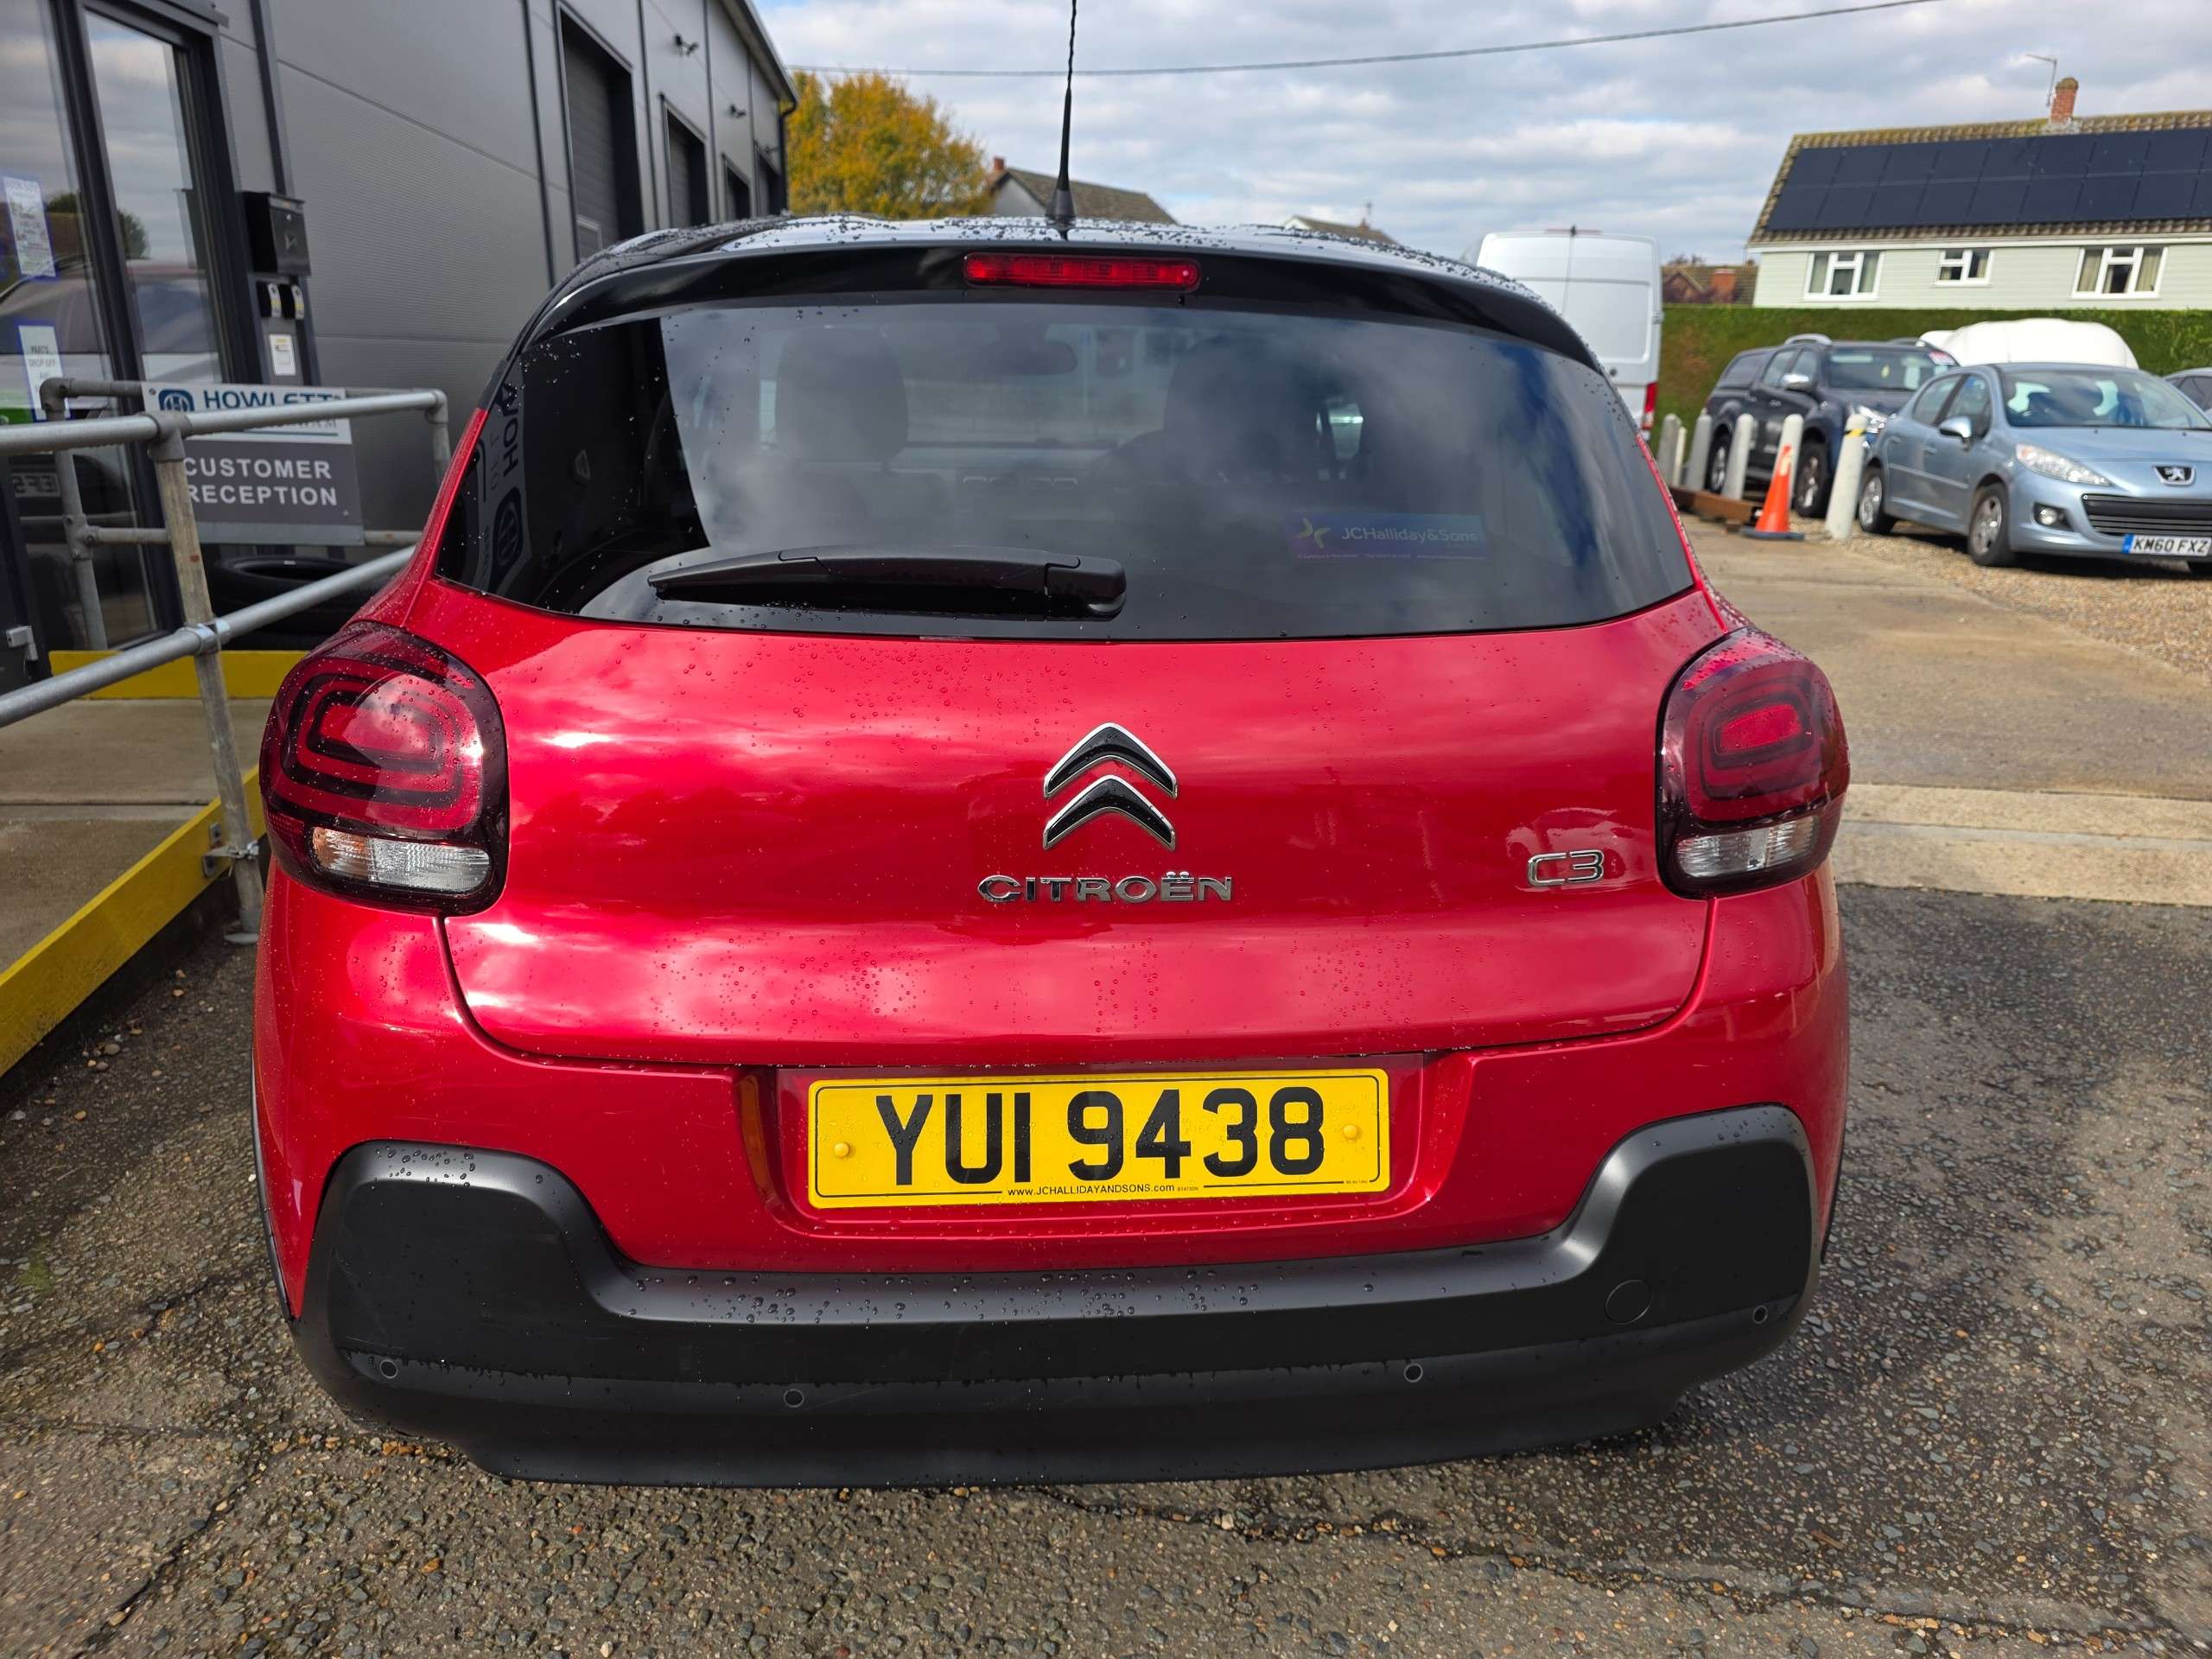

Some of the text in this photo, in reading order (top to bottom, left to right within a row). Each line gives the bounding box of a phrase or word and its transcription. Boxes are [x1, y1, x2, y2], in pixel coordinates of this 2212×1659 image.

[183, 457, 332, 480] CUSTOMER
[188, 485, 337, 506] RECEPTION
[2133, 537, 2209, 553] KM60 FXZ
[1528, 849, 1605, 887] C3
[977, 871, 1232, 903] CITROËN
[875, 1086, 1325, 1185] YUI 9438
[1007, 1183, 1175, 1196] www.JCHALLIDAYANDSONS.com
